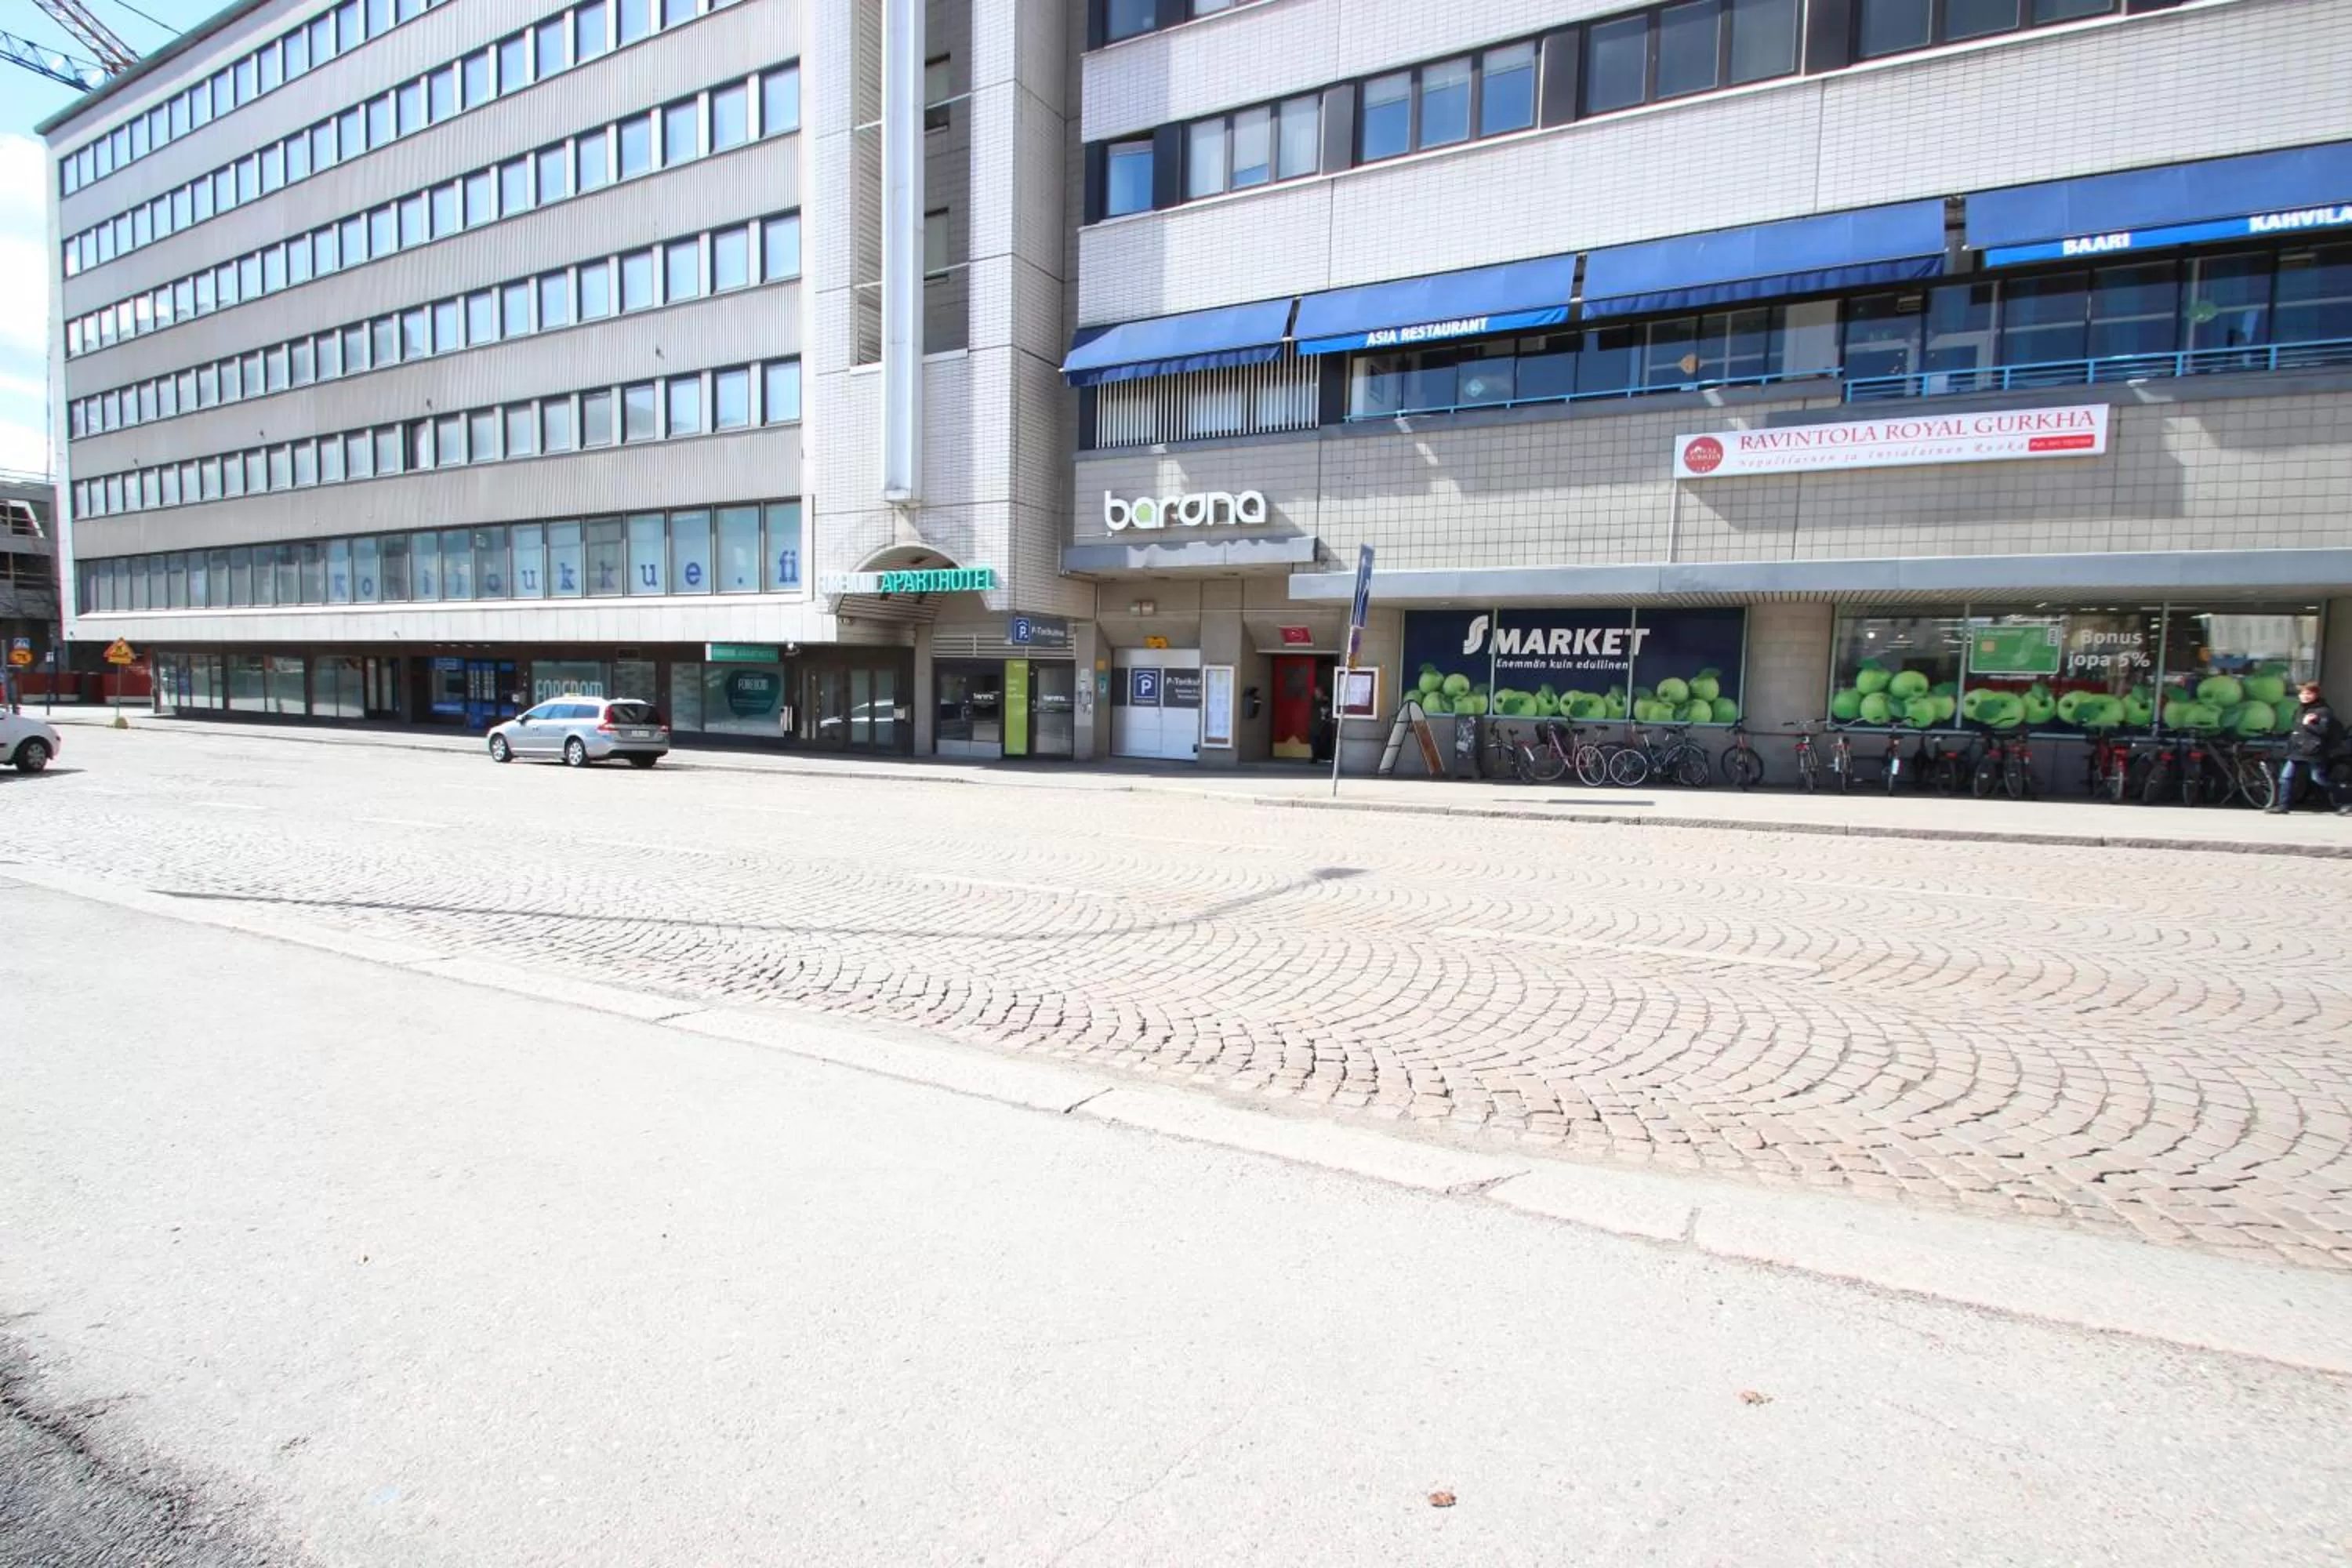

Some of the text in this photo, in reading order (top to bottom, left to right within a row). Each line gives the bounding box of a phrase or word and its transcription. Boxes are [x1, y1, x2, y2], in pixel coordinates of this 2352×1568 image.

[2249, 205, 2352, 232] KAHVILA
[2063, 233, 2131, 256] BAARI
[1367, 318, 1490, 347] ASIA RESTAURANT
[1740, 410, 2096, 451] RAVINTOLA ROYAL GURKHA
[1105, 489, 1266, 531] barona
[880, 567, 994, 593] APARTHOTEL
[1488, 628, 1650, 655] MARKET
[2081, 629, 2143, 645] Bonus
[1496, 657, 1629, 670] Enemmän kuin edullinen
[2067, 651, 2151, 670] jopa 5%
